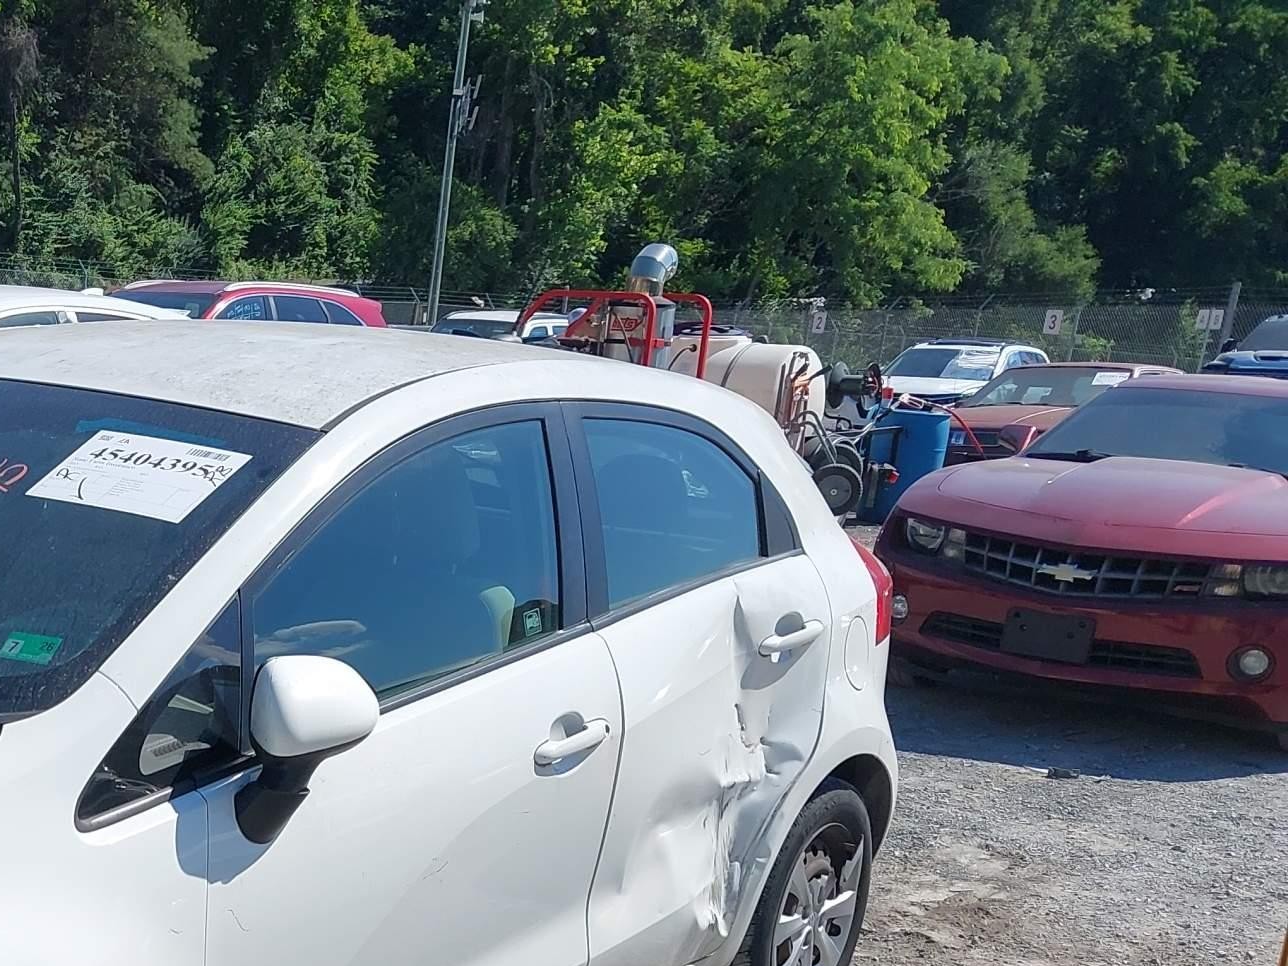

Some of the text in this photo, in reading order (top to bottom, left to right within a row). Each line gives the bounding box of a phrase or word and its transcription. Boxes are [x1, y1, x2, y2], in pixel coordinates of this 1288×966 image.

[815, 316, 823, 330] 2
[1048, 314, 1058, 330] 3
[88, 447, 216, 477] 45404395
[8, 641, 21, 653] 7
